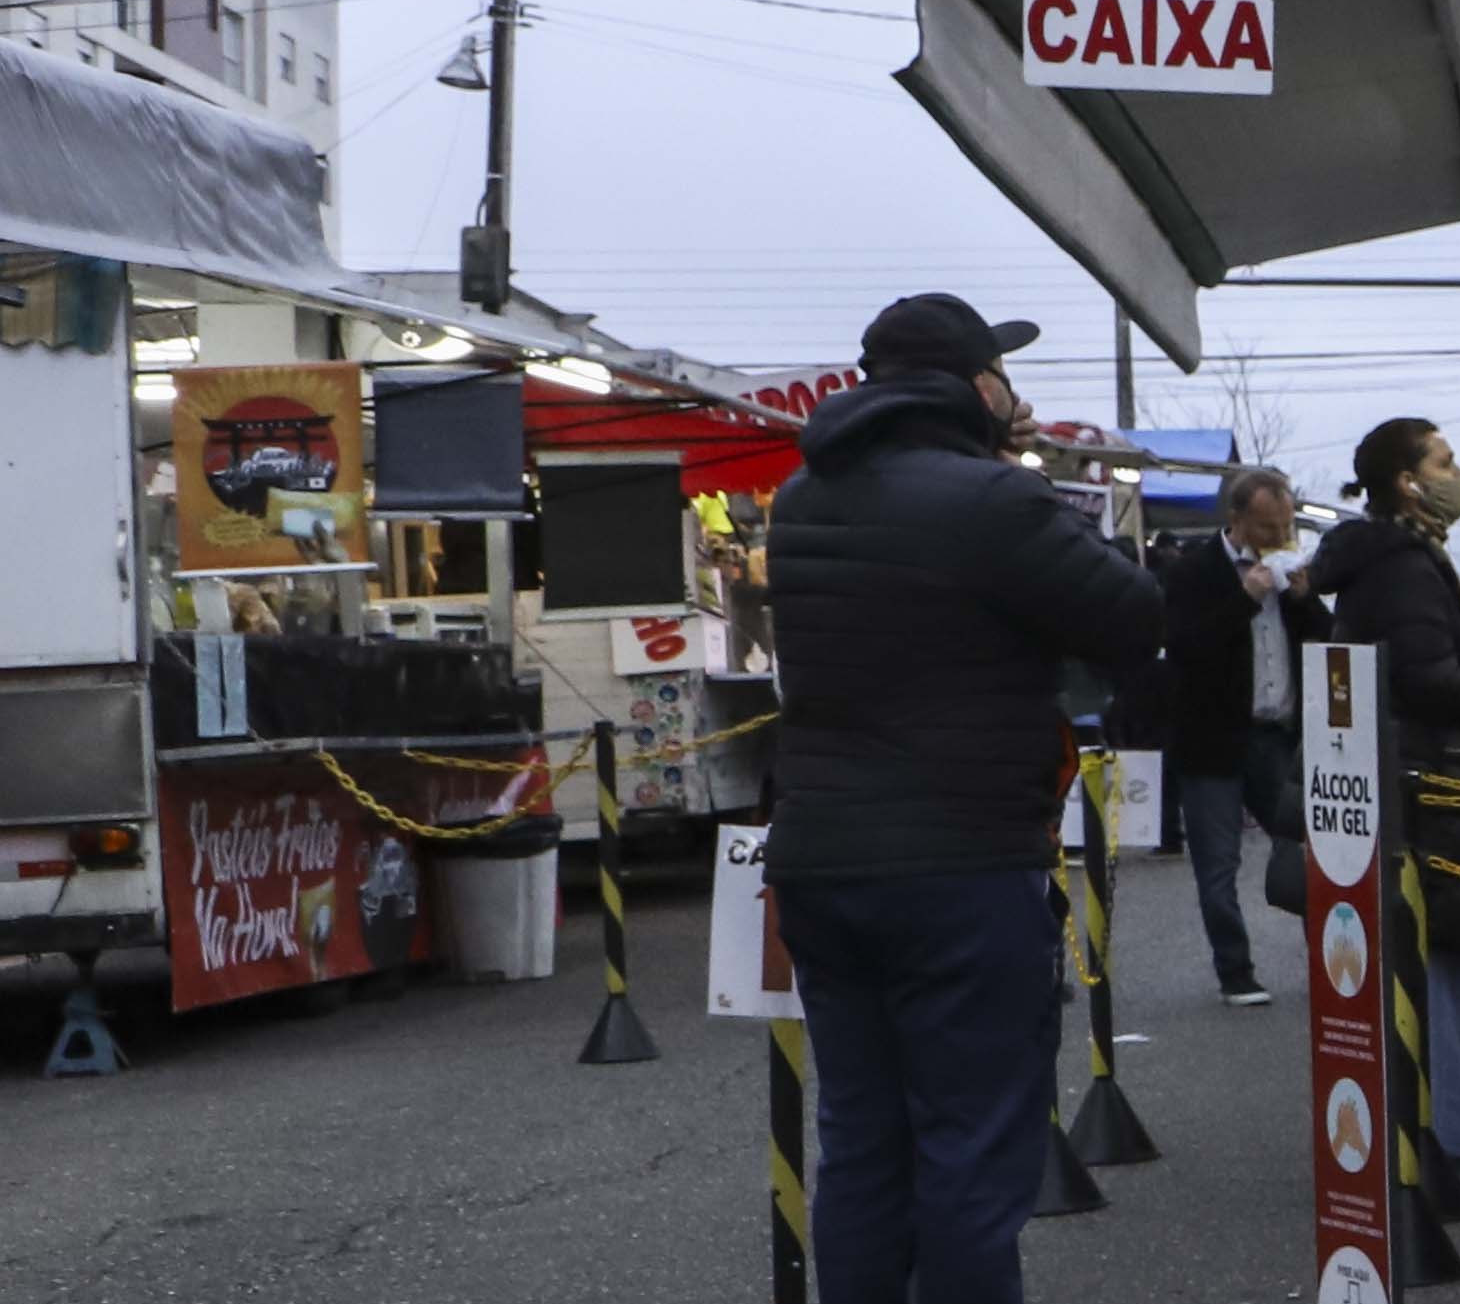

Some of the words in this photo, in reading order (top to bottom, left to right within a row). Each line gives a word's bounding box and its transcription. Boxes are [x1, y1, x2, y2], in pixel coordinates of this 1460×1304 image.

[1310, 764, 1372, 804] ÁLCOOL
[1312, 805, 1338, 834] EM
[1342, 807, 1371, 837] GEL
